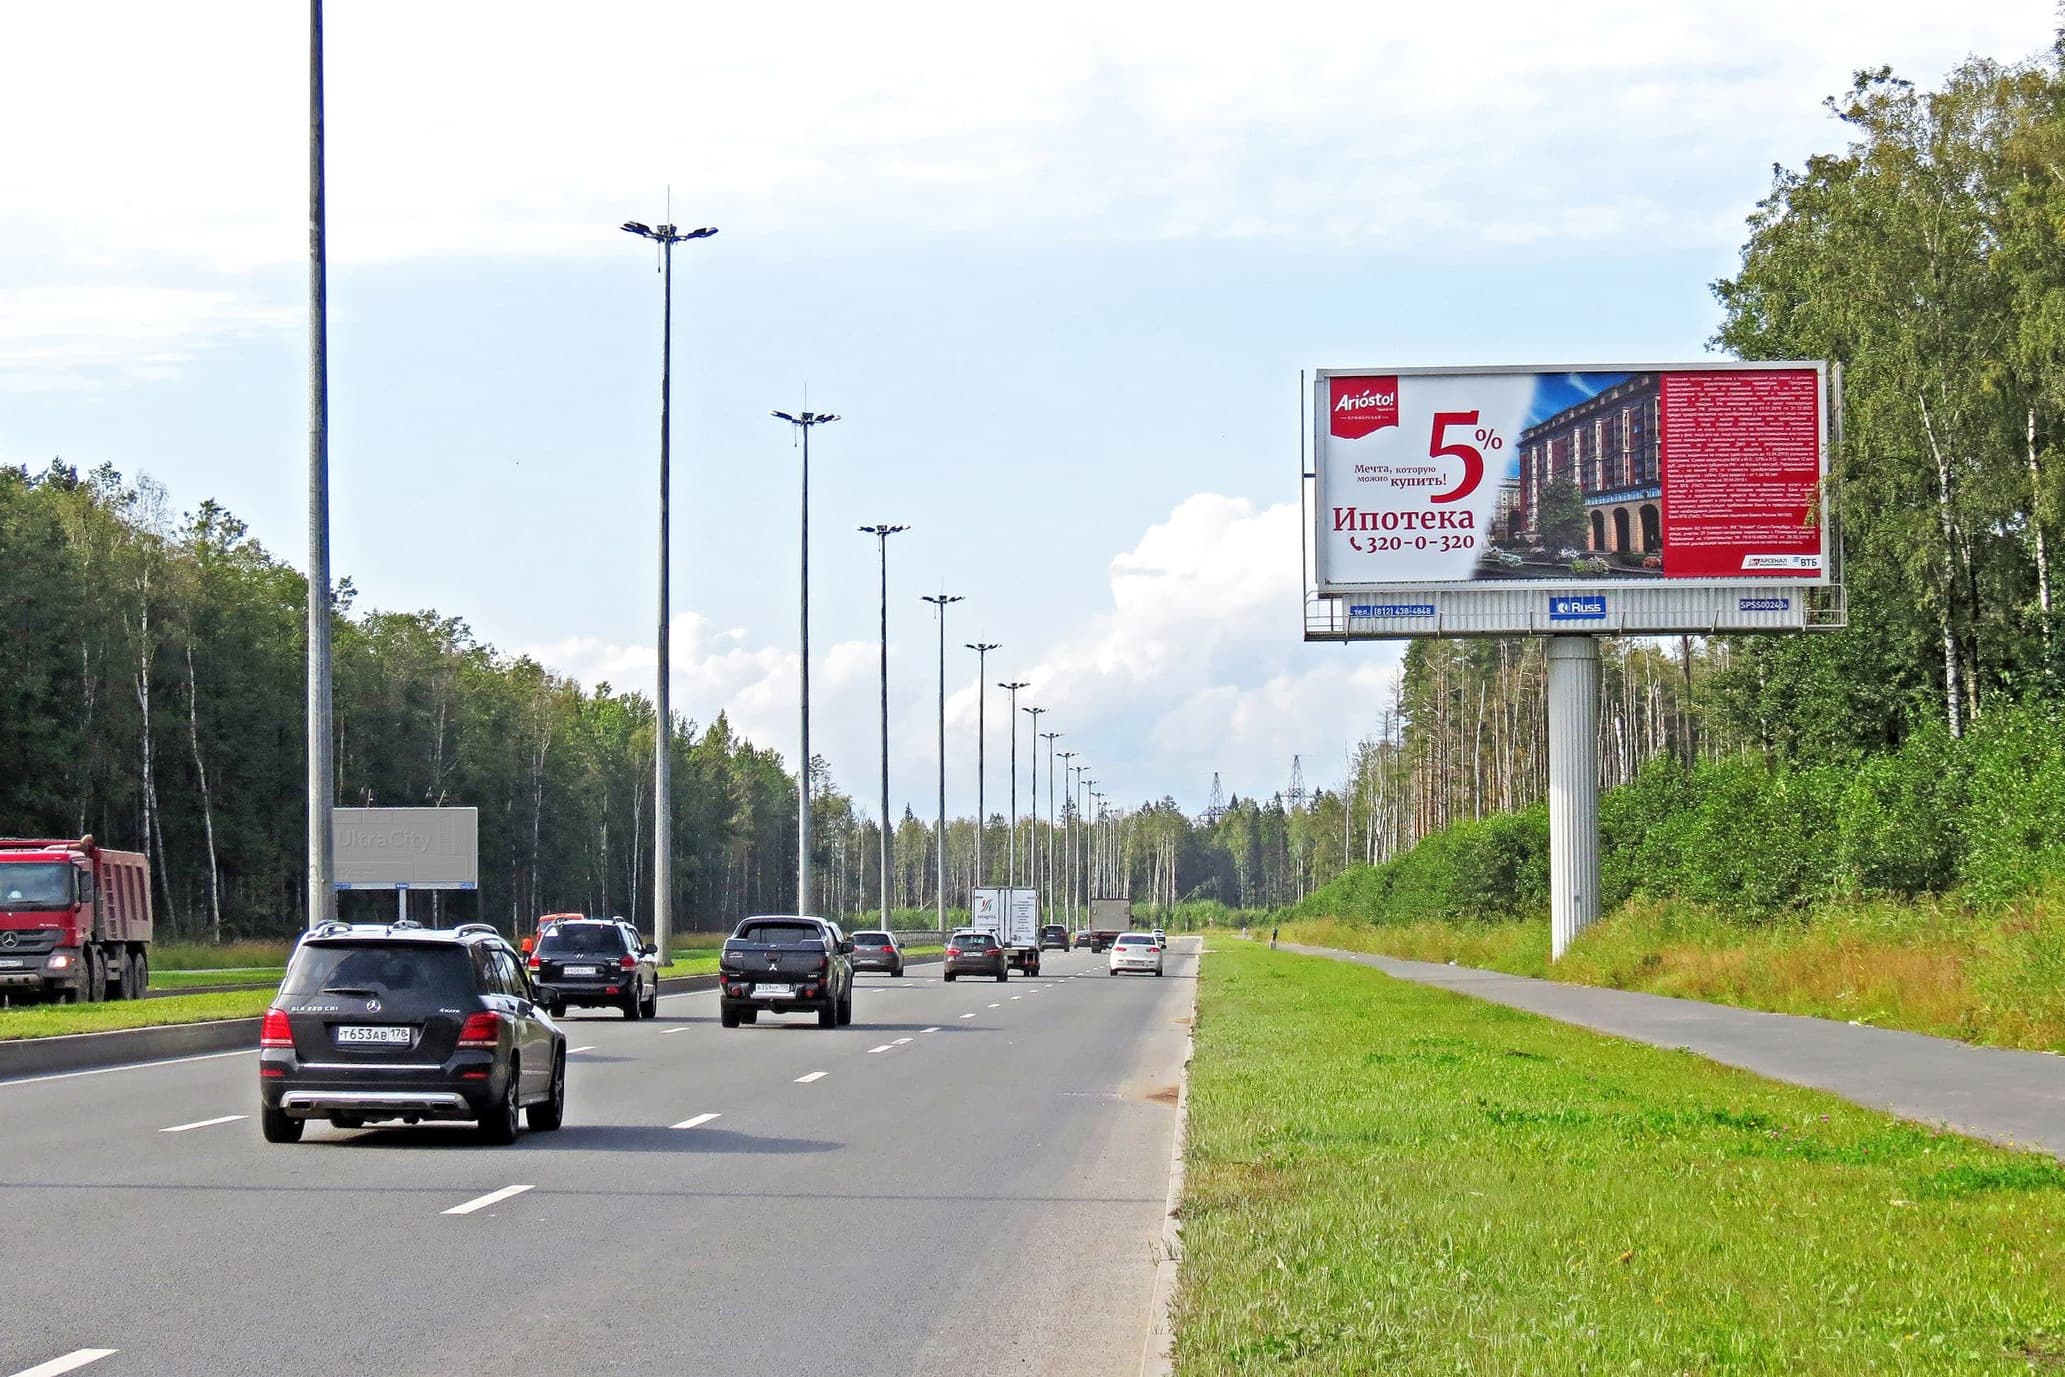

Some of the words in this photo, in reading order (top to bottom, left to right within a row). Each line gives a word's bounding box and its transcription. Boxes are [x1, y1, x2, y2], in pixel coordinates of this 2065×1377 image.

[1334, 389, 1394, 412] Ariósto!
[1354, 464, 1392, 475] Мечта,
[1395, 465, 1437, 475] которую
[1357, 475, 1389, 483] можно
[1390, 474, 1447, 490] купить!
[1332, 507, 1475, 531] Ипотека
[1366, 535, 1475, 554] 320-0-320
[1800, 558, 1818, 567] ВТБ
[1571, 602, 1601, 613] Russ
